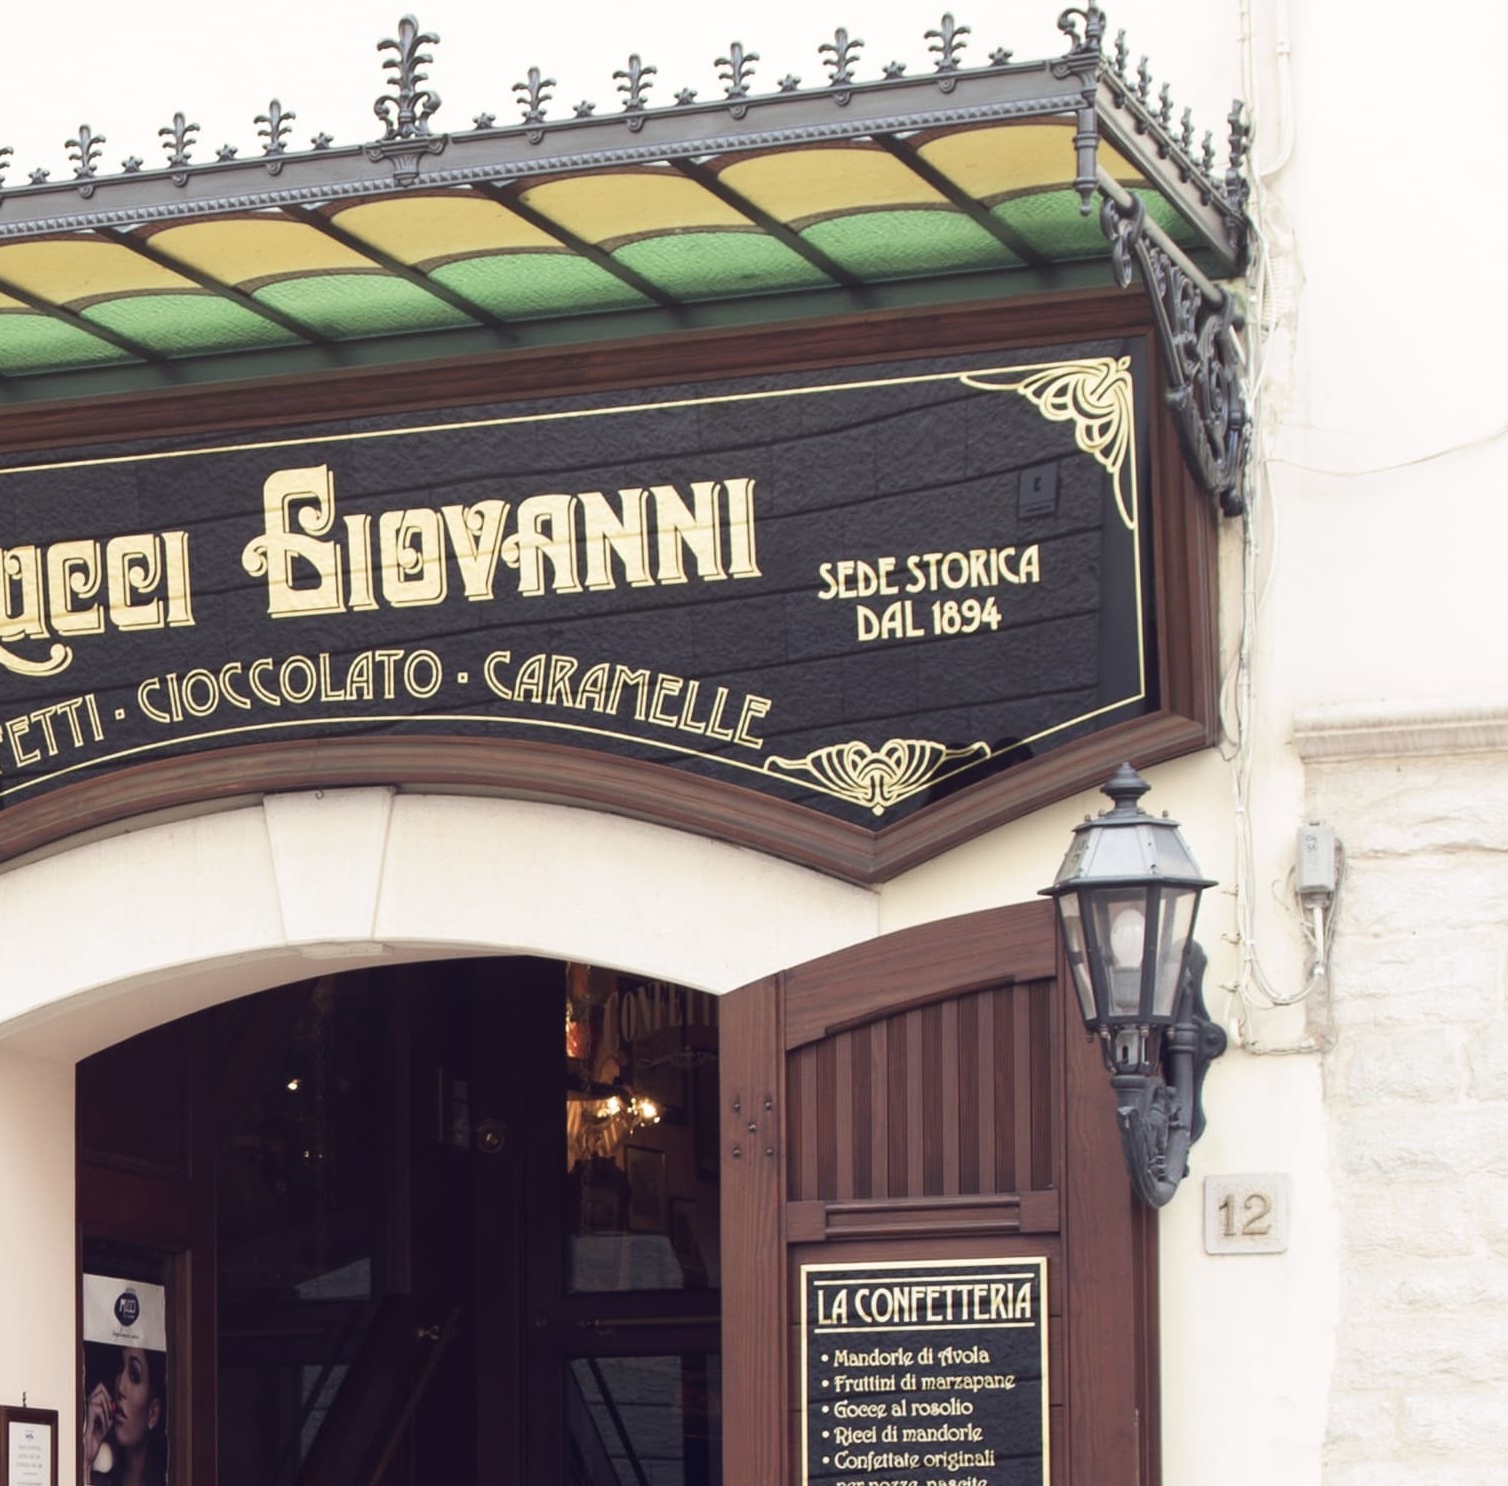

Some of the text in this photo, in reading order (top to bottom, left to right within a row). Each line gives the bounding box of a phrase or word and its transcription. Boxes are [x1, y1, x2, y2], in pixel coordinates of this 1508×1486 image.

[819, 545, 1040, 600] SEDE STORICA
[857, 596, 1003, 641] DAL 1894
[138, 649, 444, 724] CIOCCOLATO
[483, 650, 773, 749] CARAMELLE
[1218, 1193, 1272, 1236] 12
[817, 1282, 1032, 1325] LA CONFETTERIA
[833, 1346, 990, 1367] Mandorle di Avola
[834, 1373, 1016, 1393] Fruttini di marzapane
[834, 1397, 973, 1419] Gocce al rosolio
[833, 1423, 984, 1446] Ricci di mandorle
[834, 1450, 995, 1472] Confettate originali
